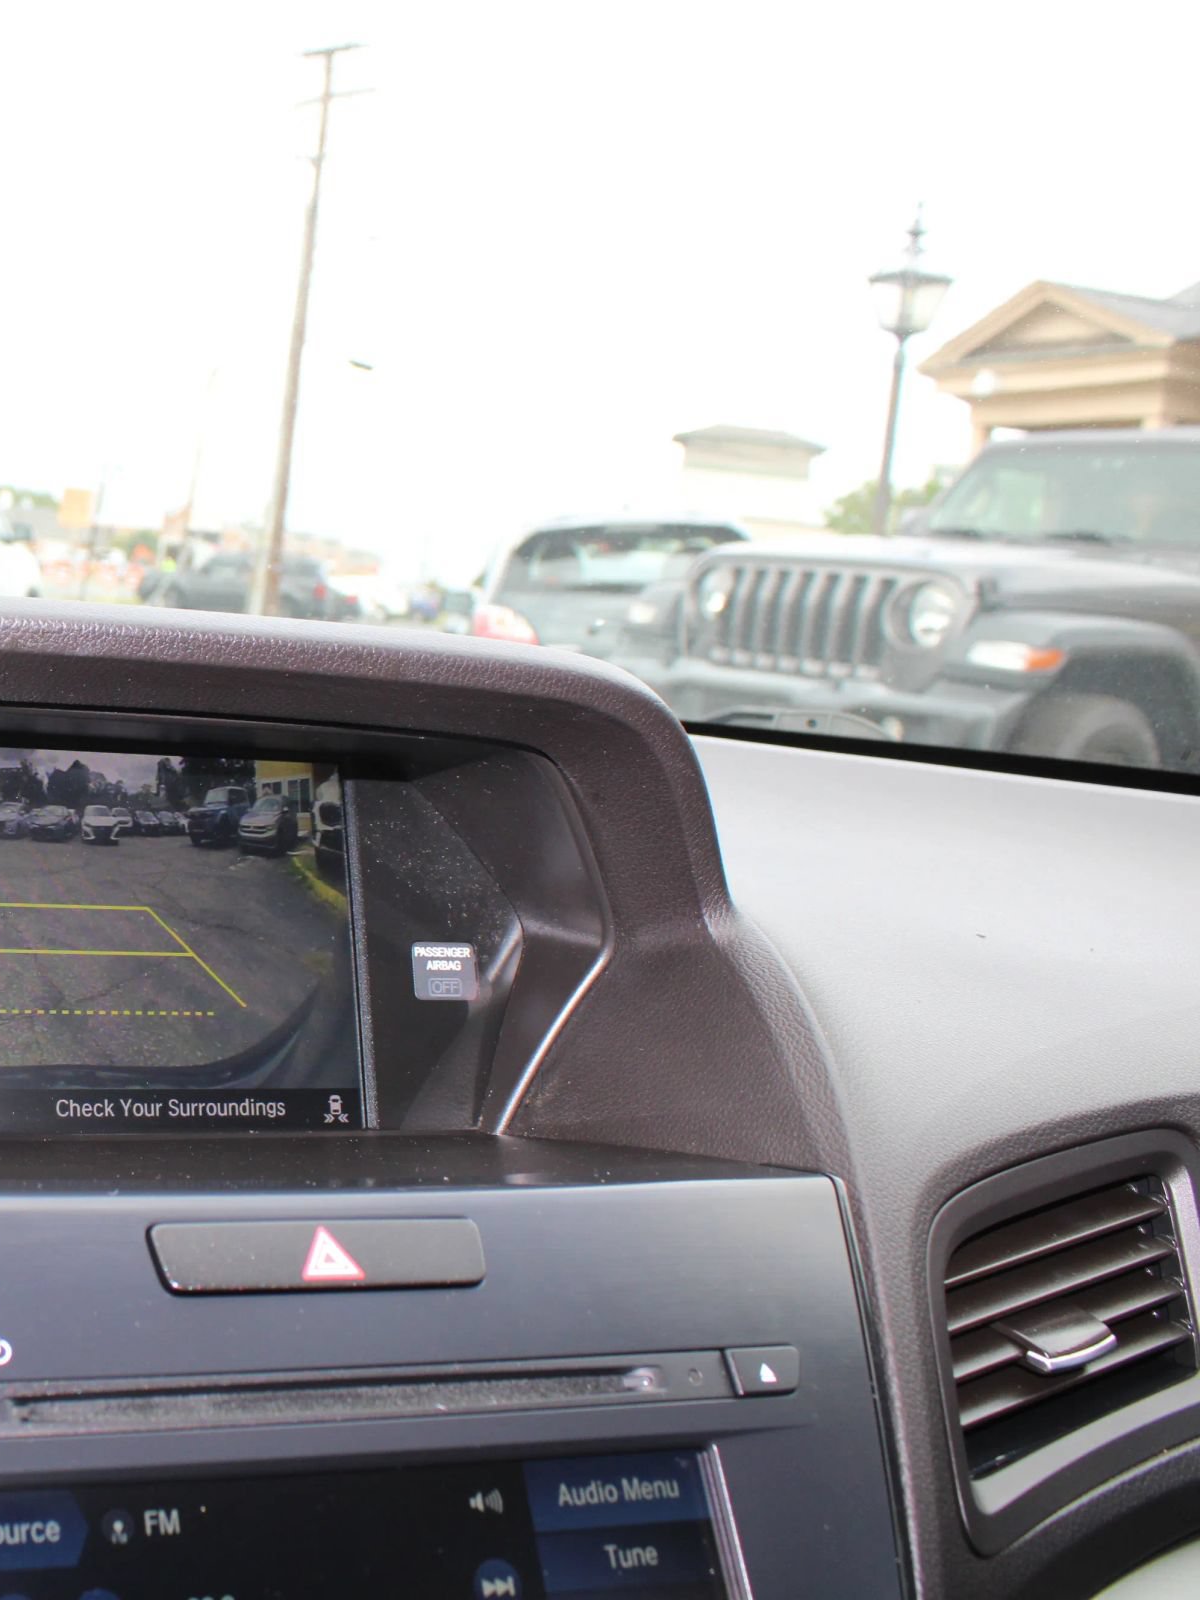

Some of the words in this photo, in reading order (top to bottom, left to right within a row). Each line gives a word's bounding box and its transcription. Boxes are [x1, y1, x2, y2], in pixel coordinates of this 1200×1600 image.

[414, 946, 471, 958] PASSENGER
[426, 960, 462, 971] AIRBAG
[431, 981, 459, 994] OFF
[56, 1099, 115, 1117] Check
[120, 1099, 163, 1117] Your
[168, 1098, 286, 1118] Surroundings
[559, 1480, 618, 1507] Audio
[621, 1477, 680, 1501] Menu
[144, 1509, 181, 1536] FM
[603, 1544, 659, 1569] Tune
